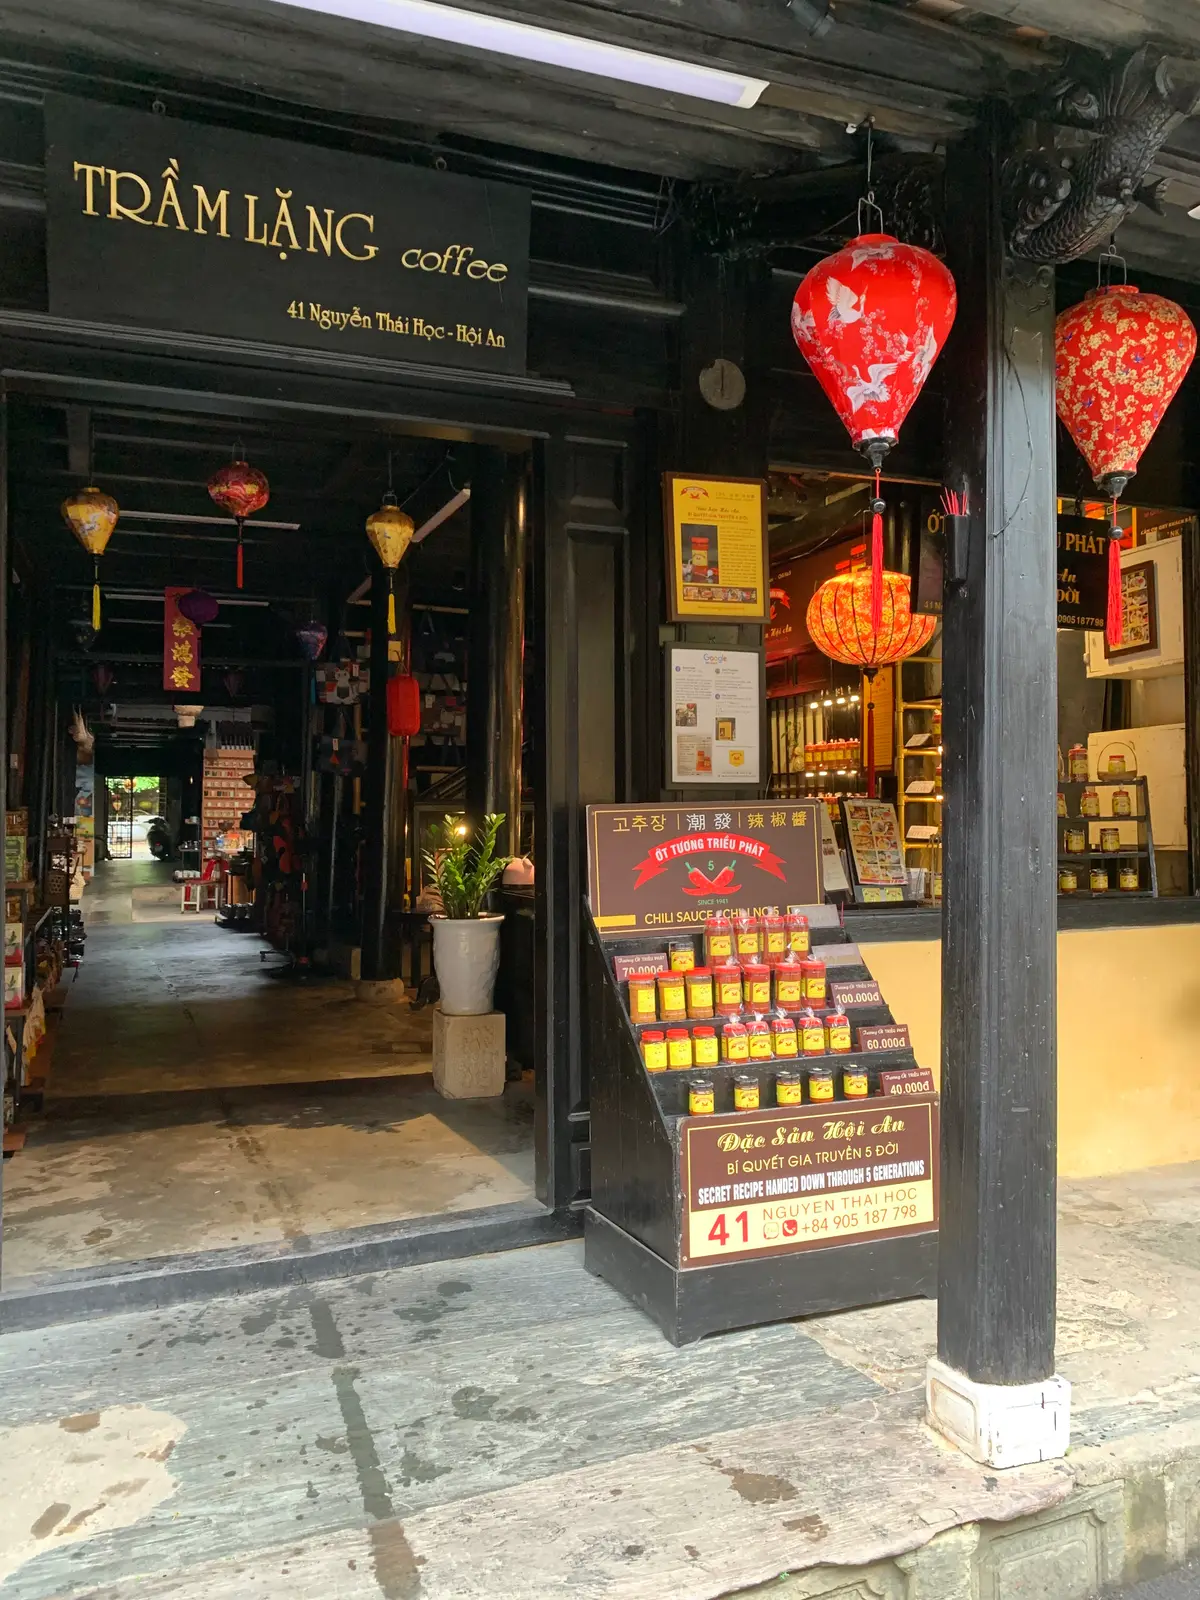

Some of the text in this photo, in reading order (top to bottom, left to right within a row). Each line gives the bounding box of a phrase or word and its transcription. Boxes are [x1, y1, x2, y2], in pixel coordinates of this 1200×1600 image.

[74, 158, 508, 282] TRẦM LẶNG coffee
[287, 300, 305, 320] 41
[309, 302, 373, 331] Nguyễn
[376, 311, 410, 335] Thái
[413, 317, 445, 341] Học
[456, 324, 483, 347] Hội
[486, 328, 506, 348] An
[1065, 530, 1106, 555] PHÁT
[613, 813, 667, 833] 고추장
[686, 812, 732, 831] 潮發
[747, 810, 807, 829] 辣椒醬
[655, 847, 669, 861] ỚT
[670, 838, 704, 856] TƯƠNG
[738, 840, 765, 857] PHÁT
[708, 860, 715, 871] 5
[645, 912, 674, 925] CHILI
[676, 910, 713, 923] SAUCE
[836, 992, 879, 1003] 100.000đ
[867, 1037, 906, 1050] 60.000đ
[890, 1080, 930, 1095] 40.000đ
[717, 1115, 906, 1153] Đặc Sản Hội An
[727, 1160, 738, 1175] BÍ
[742, 1154, 784, 1173] QUYẾT
[788, 1154, 812, 1167] GIA
[865, 1146, 872, 1158] 5
[875, 1141, 899, 1157] ĐỜI
[698, 1160, 925, 1205] SECRET RECIPE HANDED DOWN THROUGH 5 GENERATIONS
[708, 1210, 748, 1246] 41
[801, 1204, 918, 1233] +84 905 187 798
